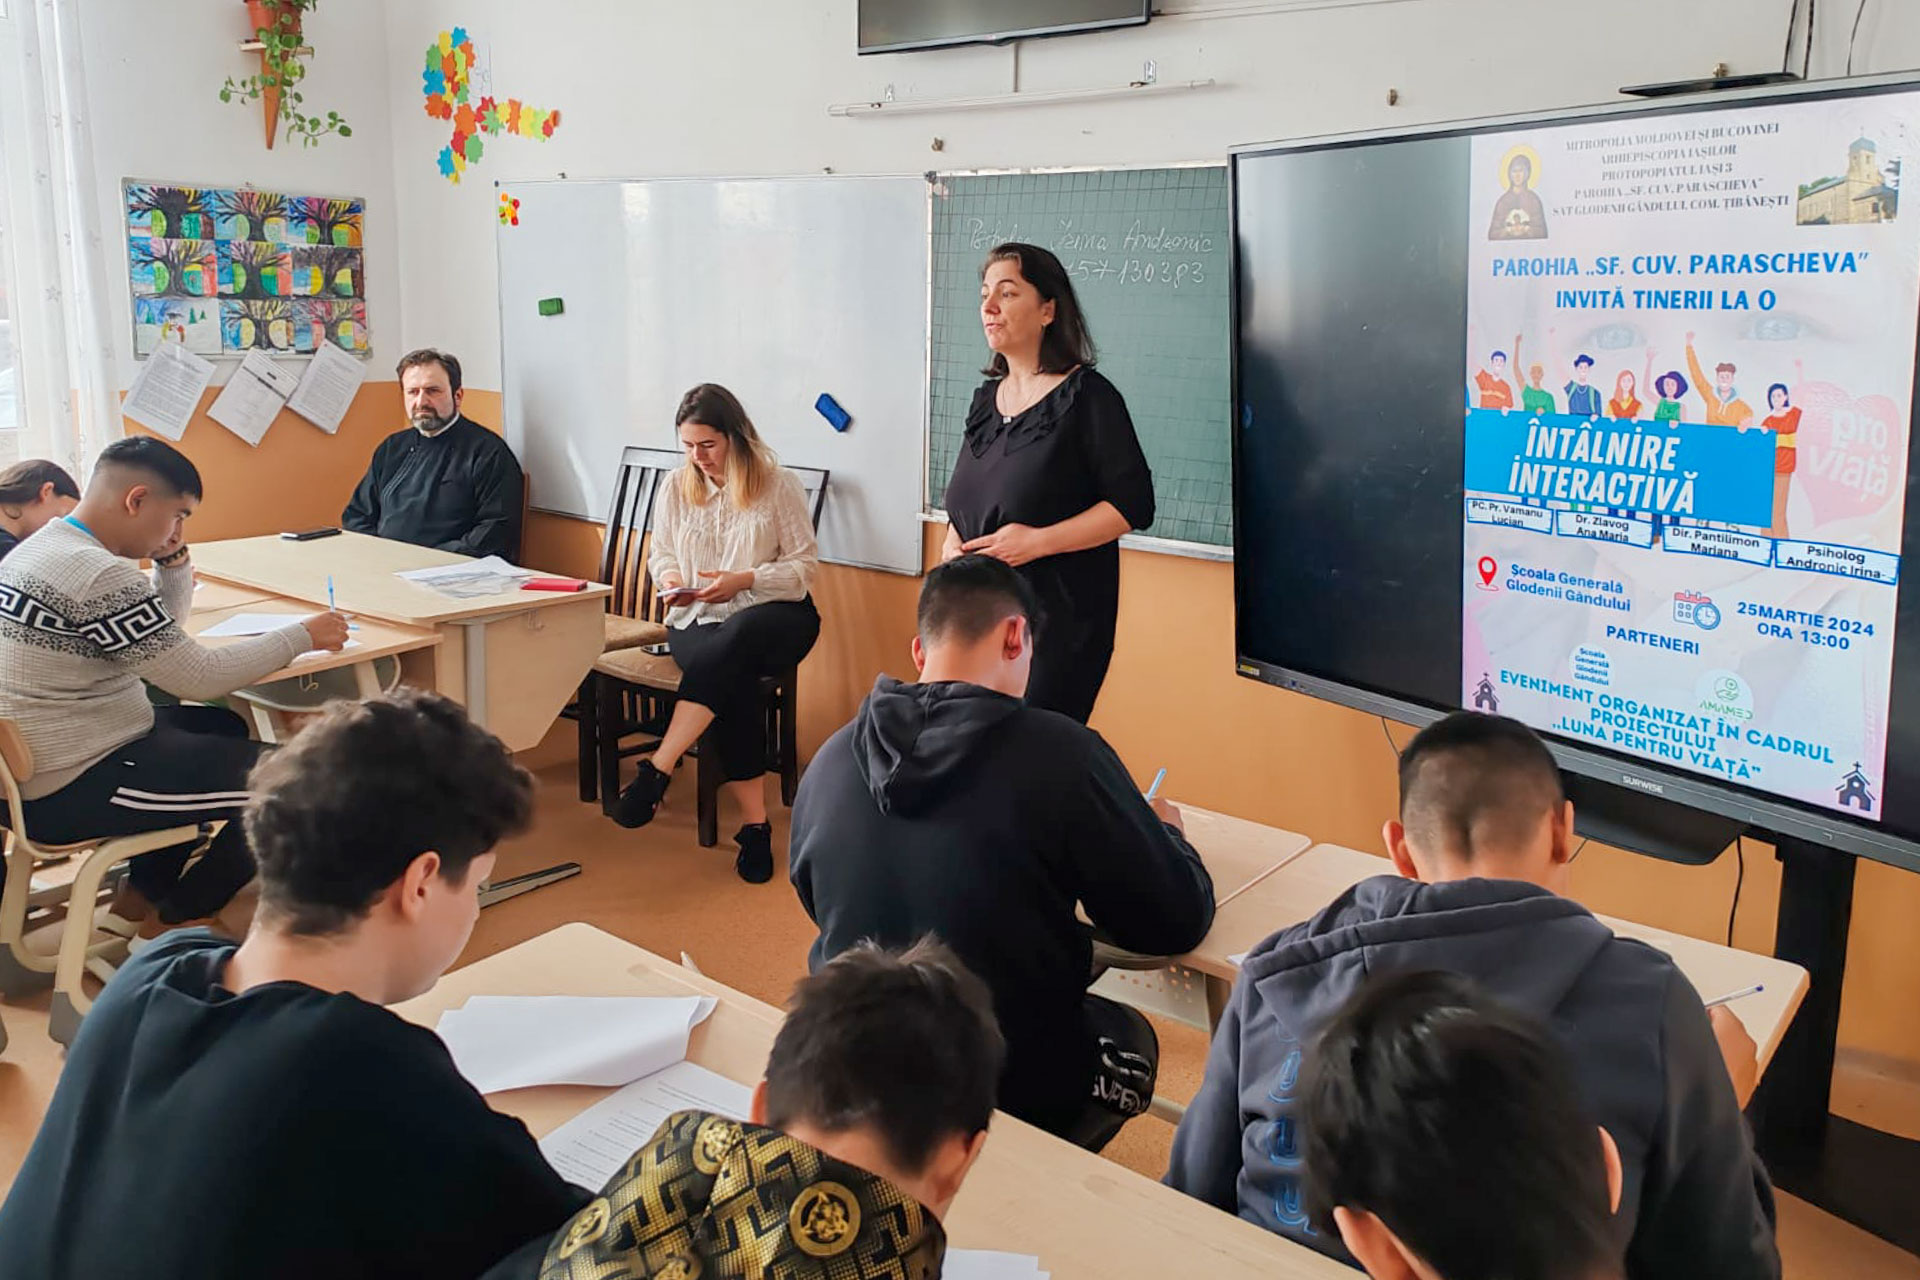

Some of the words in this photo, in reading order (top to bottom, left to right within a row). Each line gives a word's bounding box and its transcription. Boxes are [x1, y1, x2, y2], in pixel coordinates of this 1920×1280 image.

[1566, 137, 1633, 151] MITROPOLIA
[1635, 131, 1695, 145] MOLDOVEI
[1711, 123, 1780, 139] BUCOVINEI
[1601, 166, 1697, 181] PROTOPOPIATUL
[1725, 162, 1733, 173] 3
[1574, 187, 1623, 200] PAROHIA
[1123, 219, 1213, 253] Andronic
[1492, 257, 1579, 277] PAROHIA
[1632, 254, 1682, 275] CUV.
[1556, 286, 1626, 310] INVITĂ
[1633, 289, 1713, 310] TINERII
[1721, 289, 1750, 311] LA
[1758, 288, 1776, 312] O
[1832, 409, 1887, 451] pro
[1491, 514, 1524, 527] Lucian
[1504, 503, 1544, 519] Vamanu
[1575, 514, 1591, 525] Dr.
[1593, 516, 1630, 532] Zlavog
[1576, 527, 1597, 539] Ana
[1599, 529, 1630, 543] Maria
[1672, 527, 1692, 539] Dir.
[1694, 529, 1760, 549] Pantilimon
[1690, 543, 1739, 559] Mariana
[1807, 545, 1866, 565] Psiholog
[1786, 556, 1847, 575] Andronic
[1511, 563, 1556, 582] Școala
[1558, 572, 1624, 594] Generală
[1506, 578, 1563, 599] Glodenii
[1565, 589, 1631, 612] Gândului
[1757, 622, 1793, 640] ORA
[1800, 630, 1850, 650] 13:00
[1828, 617, 1874, 637] 2024
[1606, 625, 1700, 656] PARTENERI
[1500, 670, 1593, 704] EVENIMENT
[1598, 694, 1711, 733] ORGANIZAT
[1717, 717, 1741, 741] ÎN
[1746, 729, 1835, 764] CADRUL
[1590, 707, 1717, 751] PROIECTULUI
[1612, 730, 1683, 761] PENTRU
[1622, 774, 1664, 794] SURWISE
